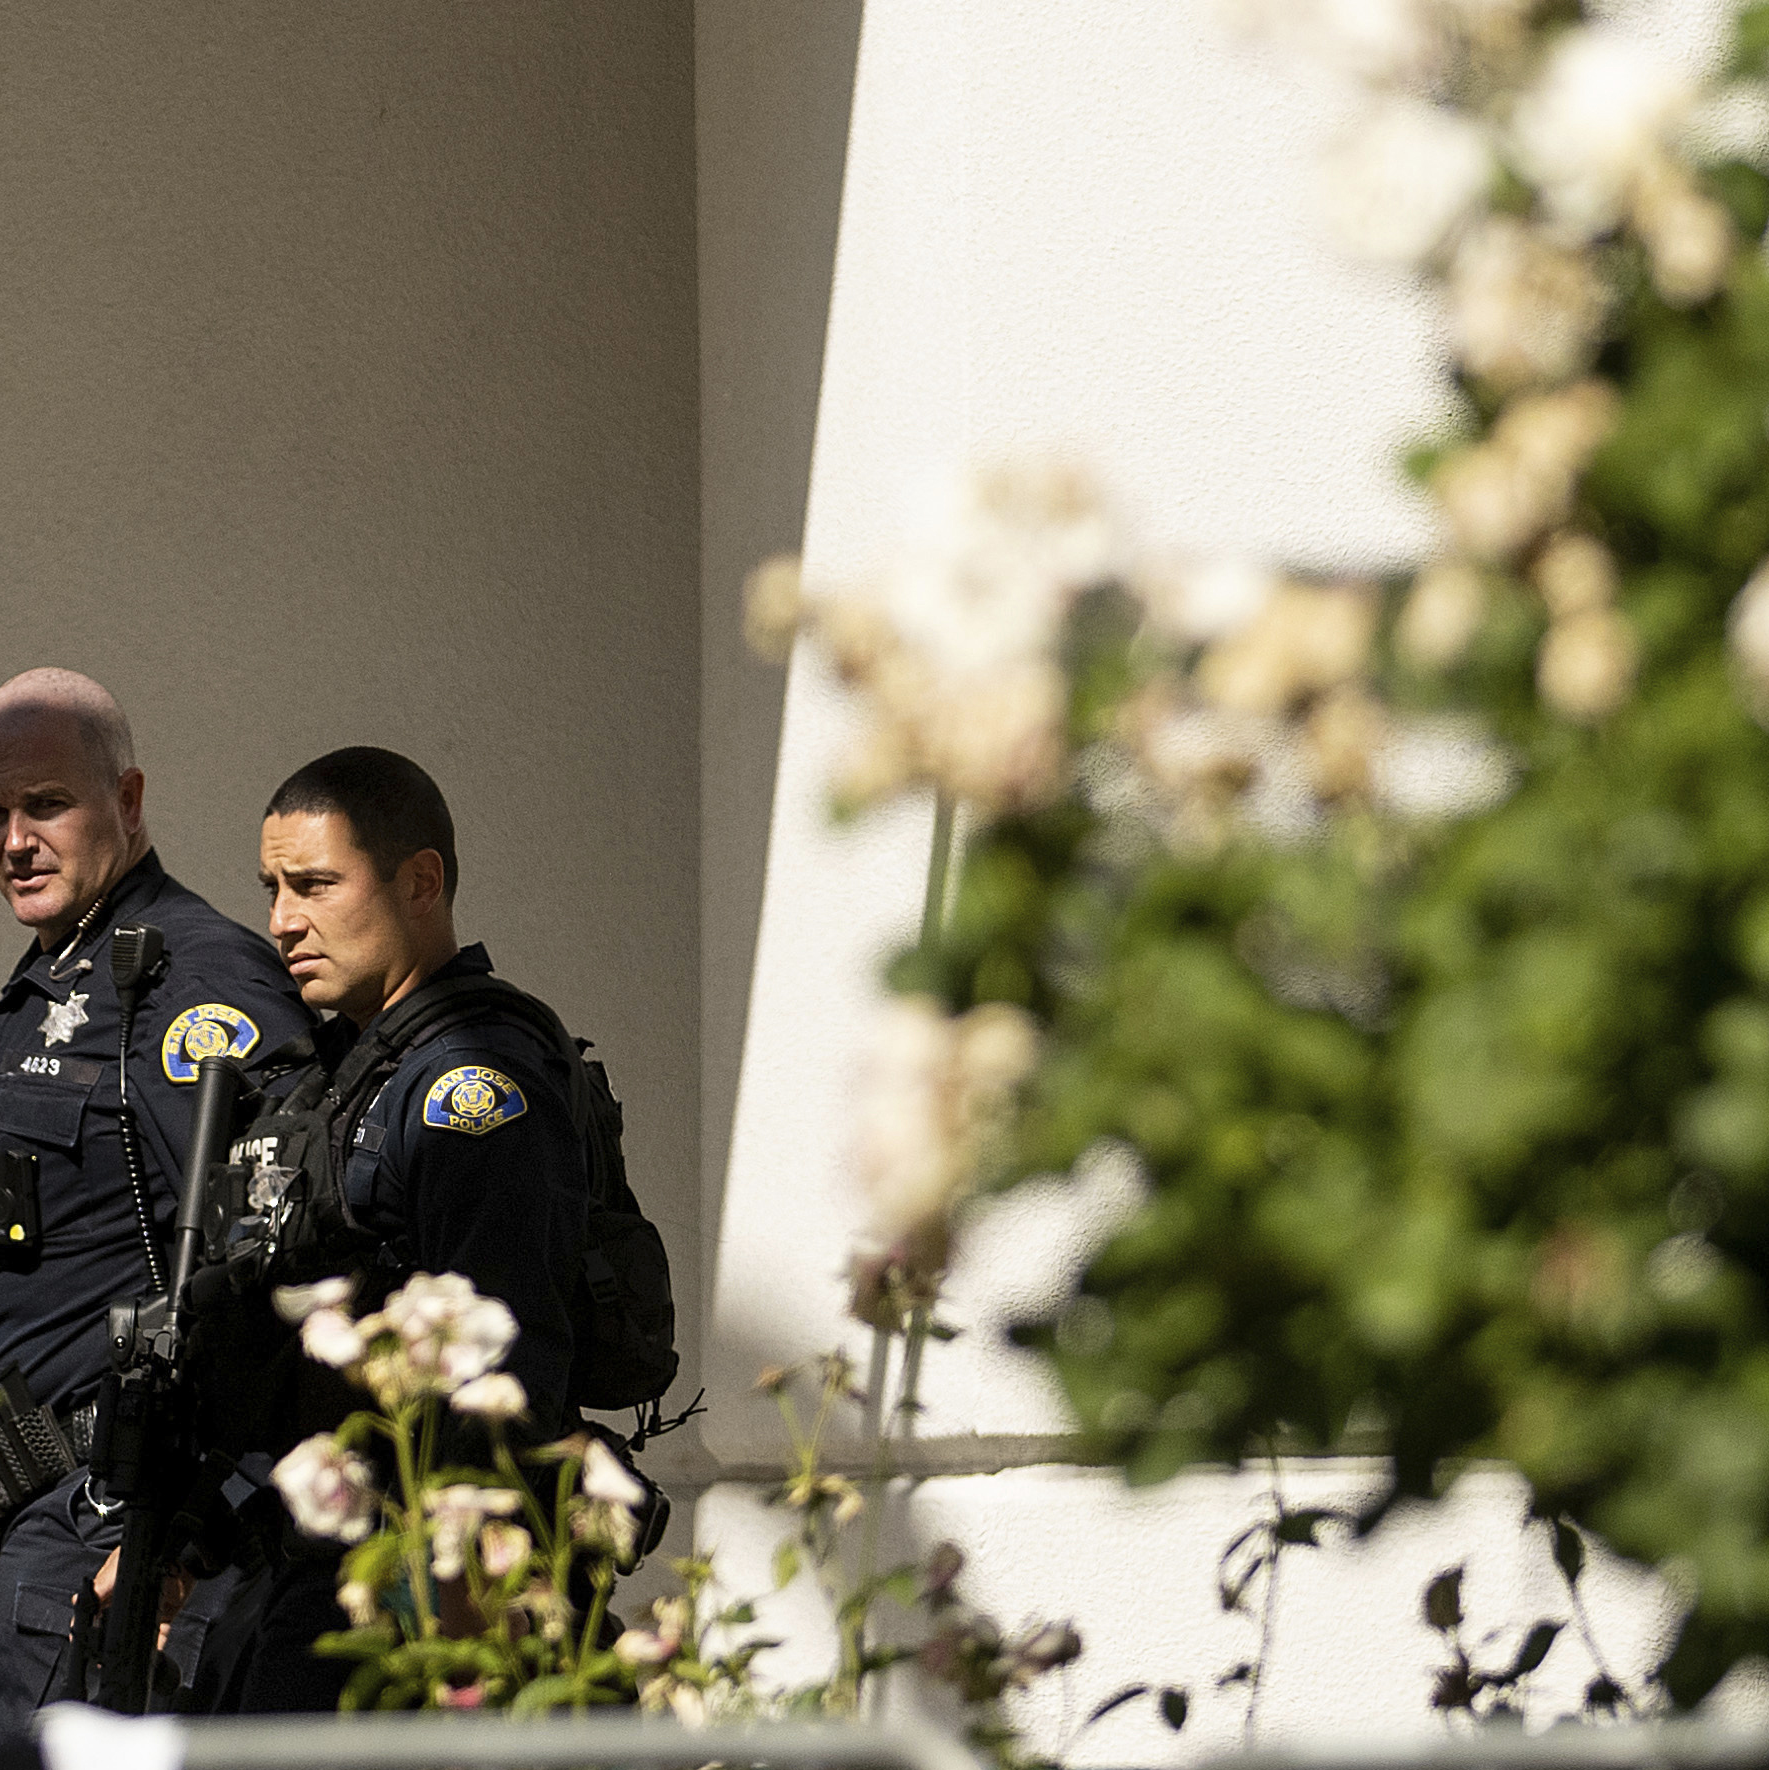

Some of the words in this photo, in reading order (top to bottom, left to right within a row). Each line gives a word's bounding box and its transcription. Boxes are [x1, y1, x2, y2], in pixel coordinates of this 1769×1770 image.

[166, 1016, 192, 1055] SAN
[193, 1006, 241, 1027] JOSE
[431, 1070, 465, 1102] SAN
[469, 1068, 517, 1096] JOSE
[448, 1107, 504, 1132] POLICE
